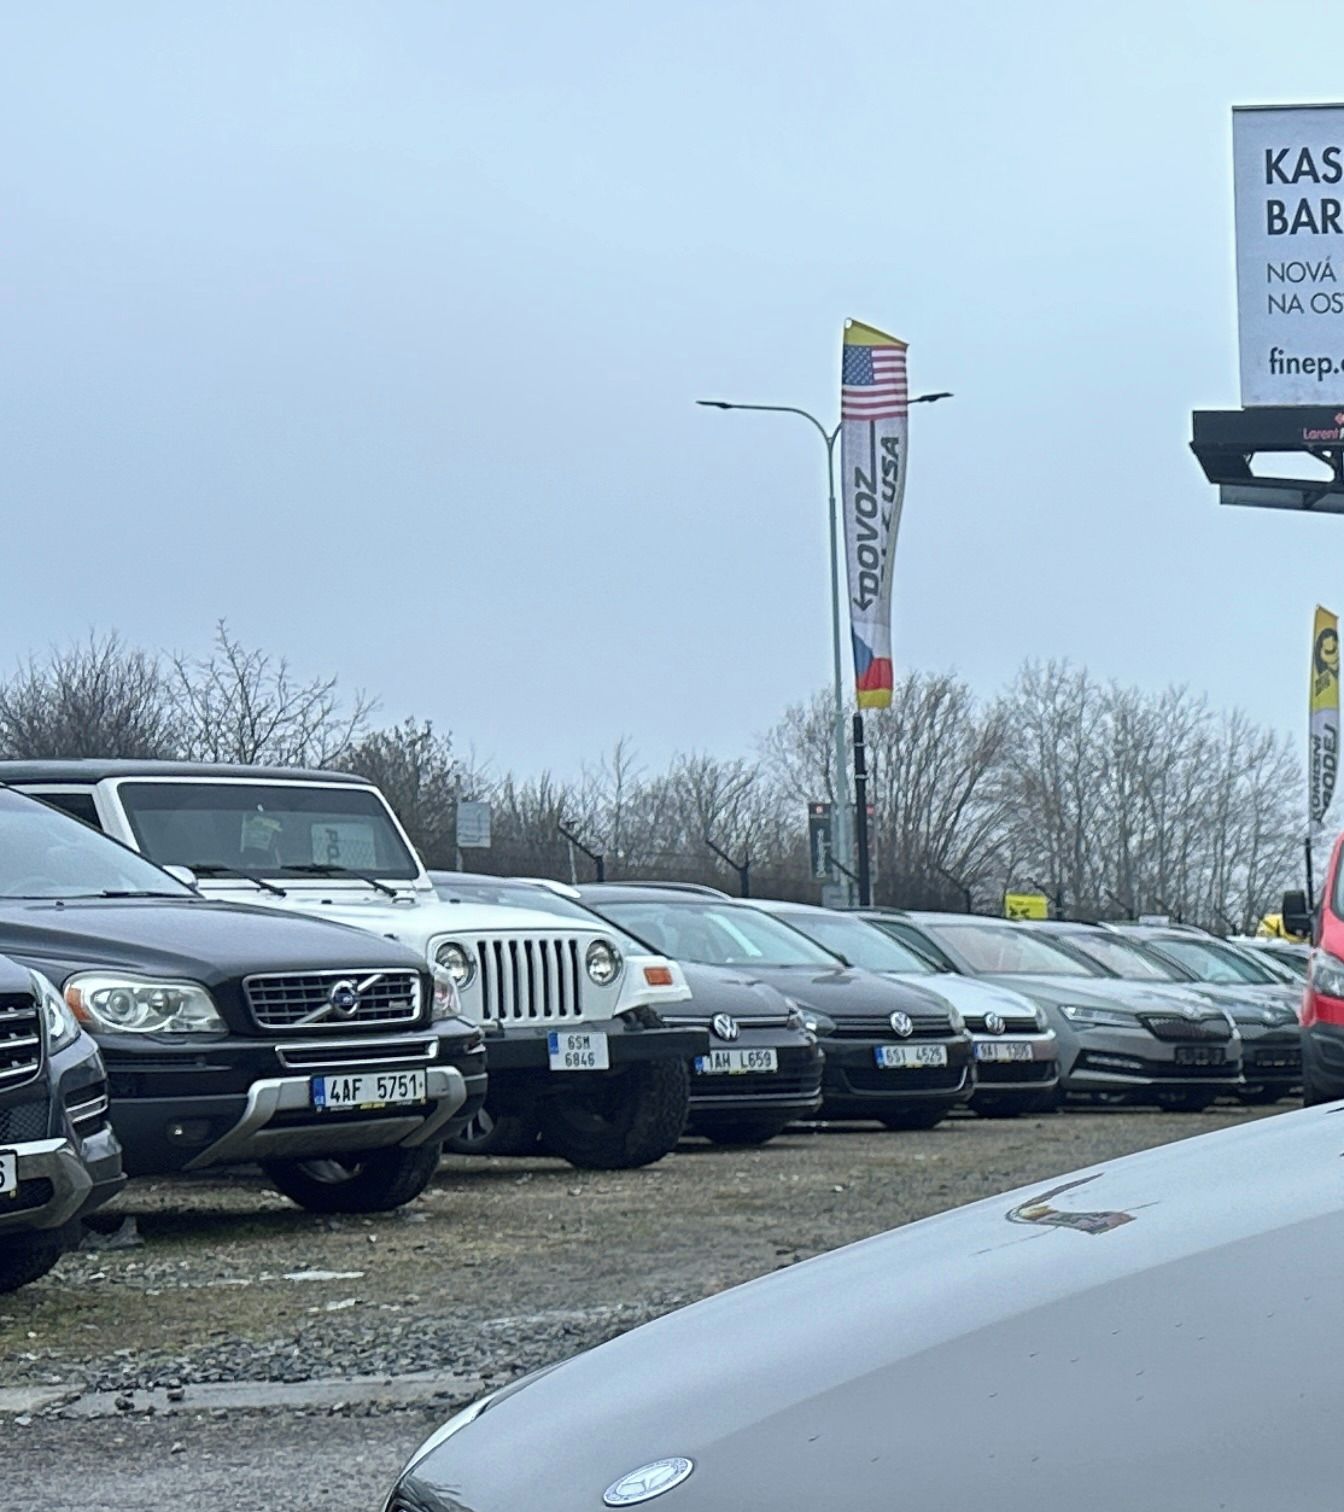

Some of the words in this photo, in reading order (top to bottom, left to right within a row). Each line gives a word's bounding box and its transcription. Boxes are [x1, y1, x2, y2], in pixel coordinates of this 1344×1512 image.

[1267, 256, 1336, 283] NOVÁ
[1268, 294, 1304, 314] NA
[854, 467, 878, 598] DOVOZ
[330, 1079, 362, 1102] 4AF
[377, 1074, 418, 1099] 5751
